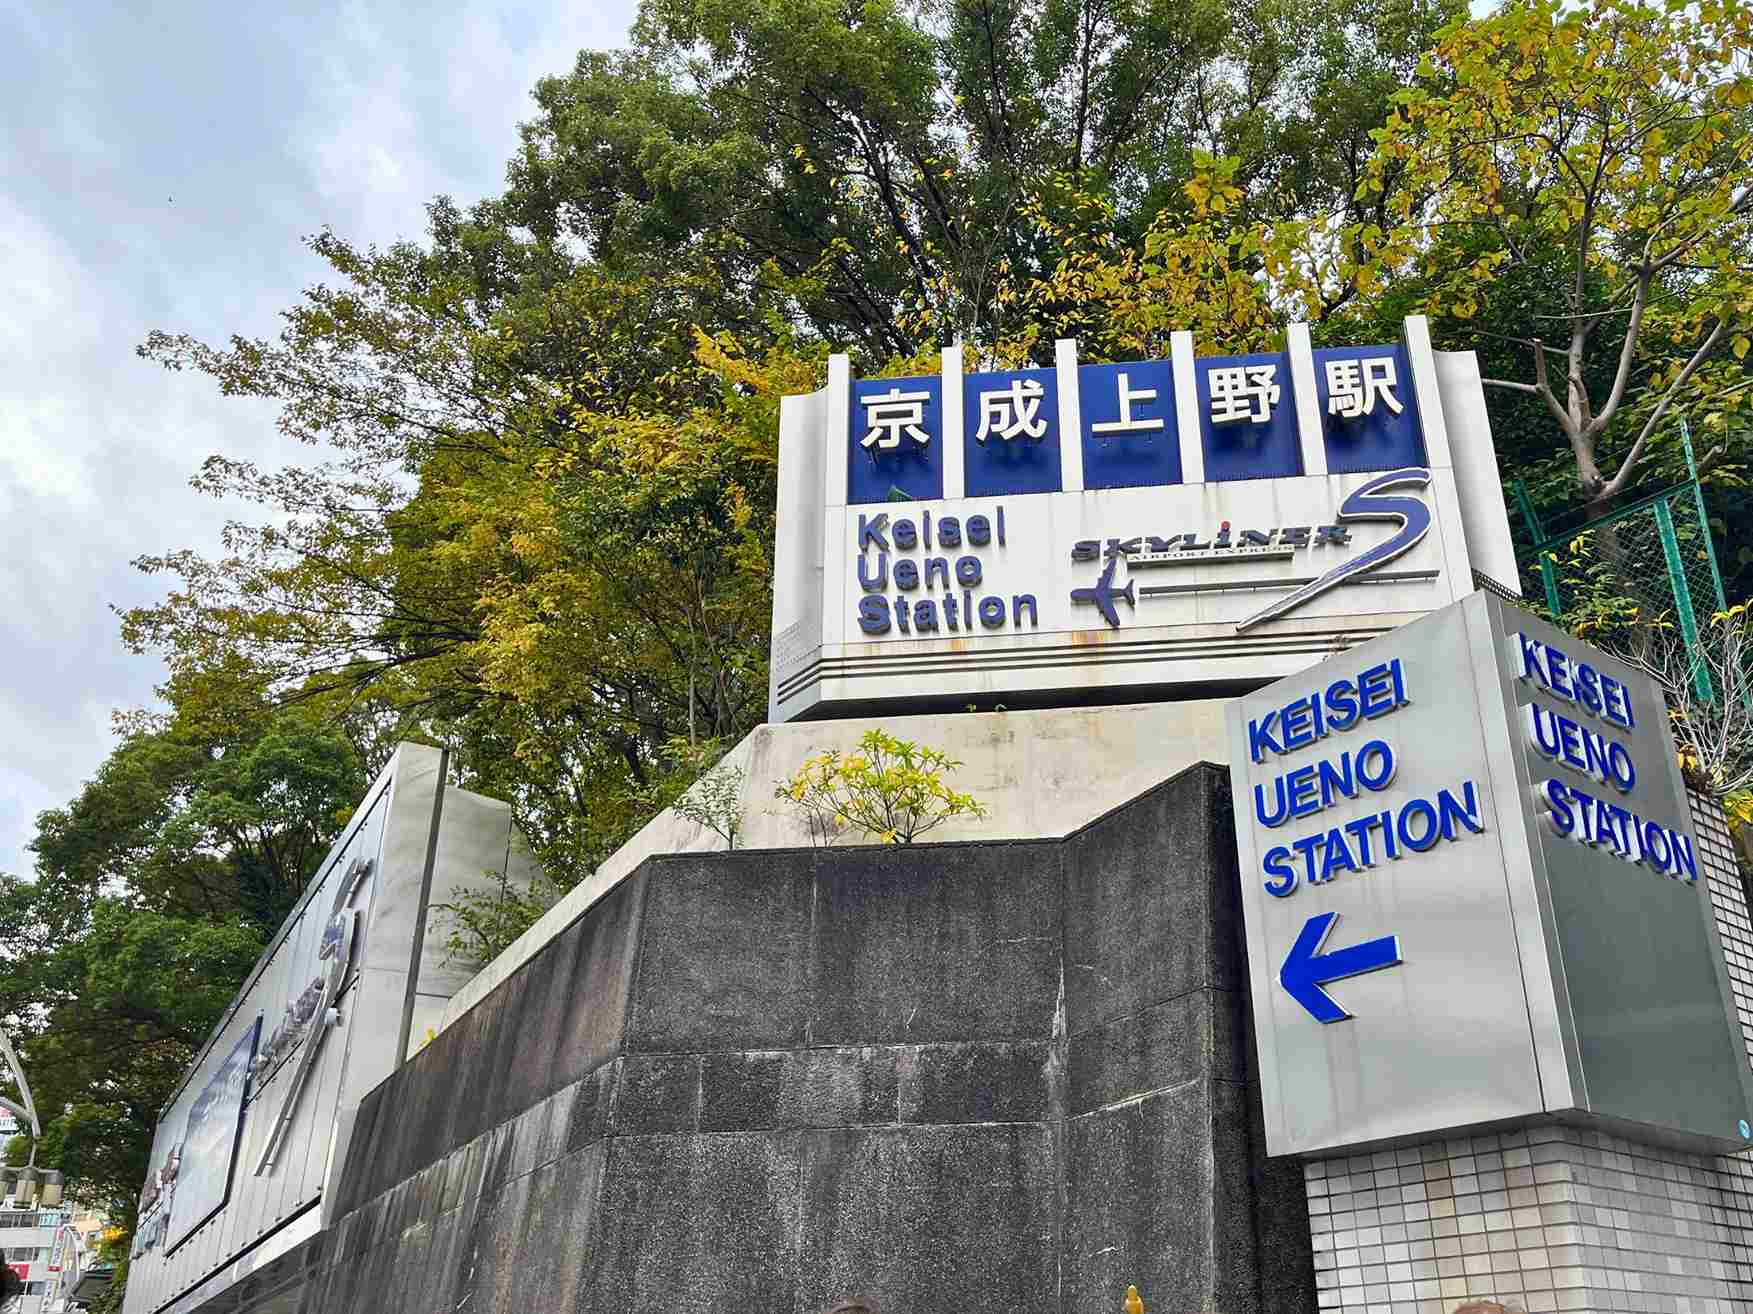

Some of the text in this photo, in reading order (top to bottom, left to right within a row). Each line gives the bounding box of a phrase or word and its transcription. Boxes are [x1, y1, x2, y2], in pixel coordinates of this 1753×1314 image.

[860, 357, 1404, 448] 京成上野駅
[858, 506, 1007, 551] Keisei
[858, 553, 983, 593] Ueno
[1129, 549, 1206, 561] AIRPORT
[858, 590, 1038, 635] Station
[1249, 657, 1409, 763] KEISEI
[1514, 632, 1635, 730] KEISEI
[1254, 739, 1398, 828] UENO
[1526, 702, 1636, 793] UENO
[1263, 781, 1484, 898] STATION
[1545, 778, 1697, 882] STATION
